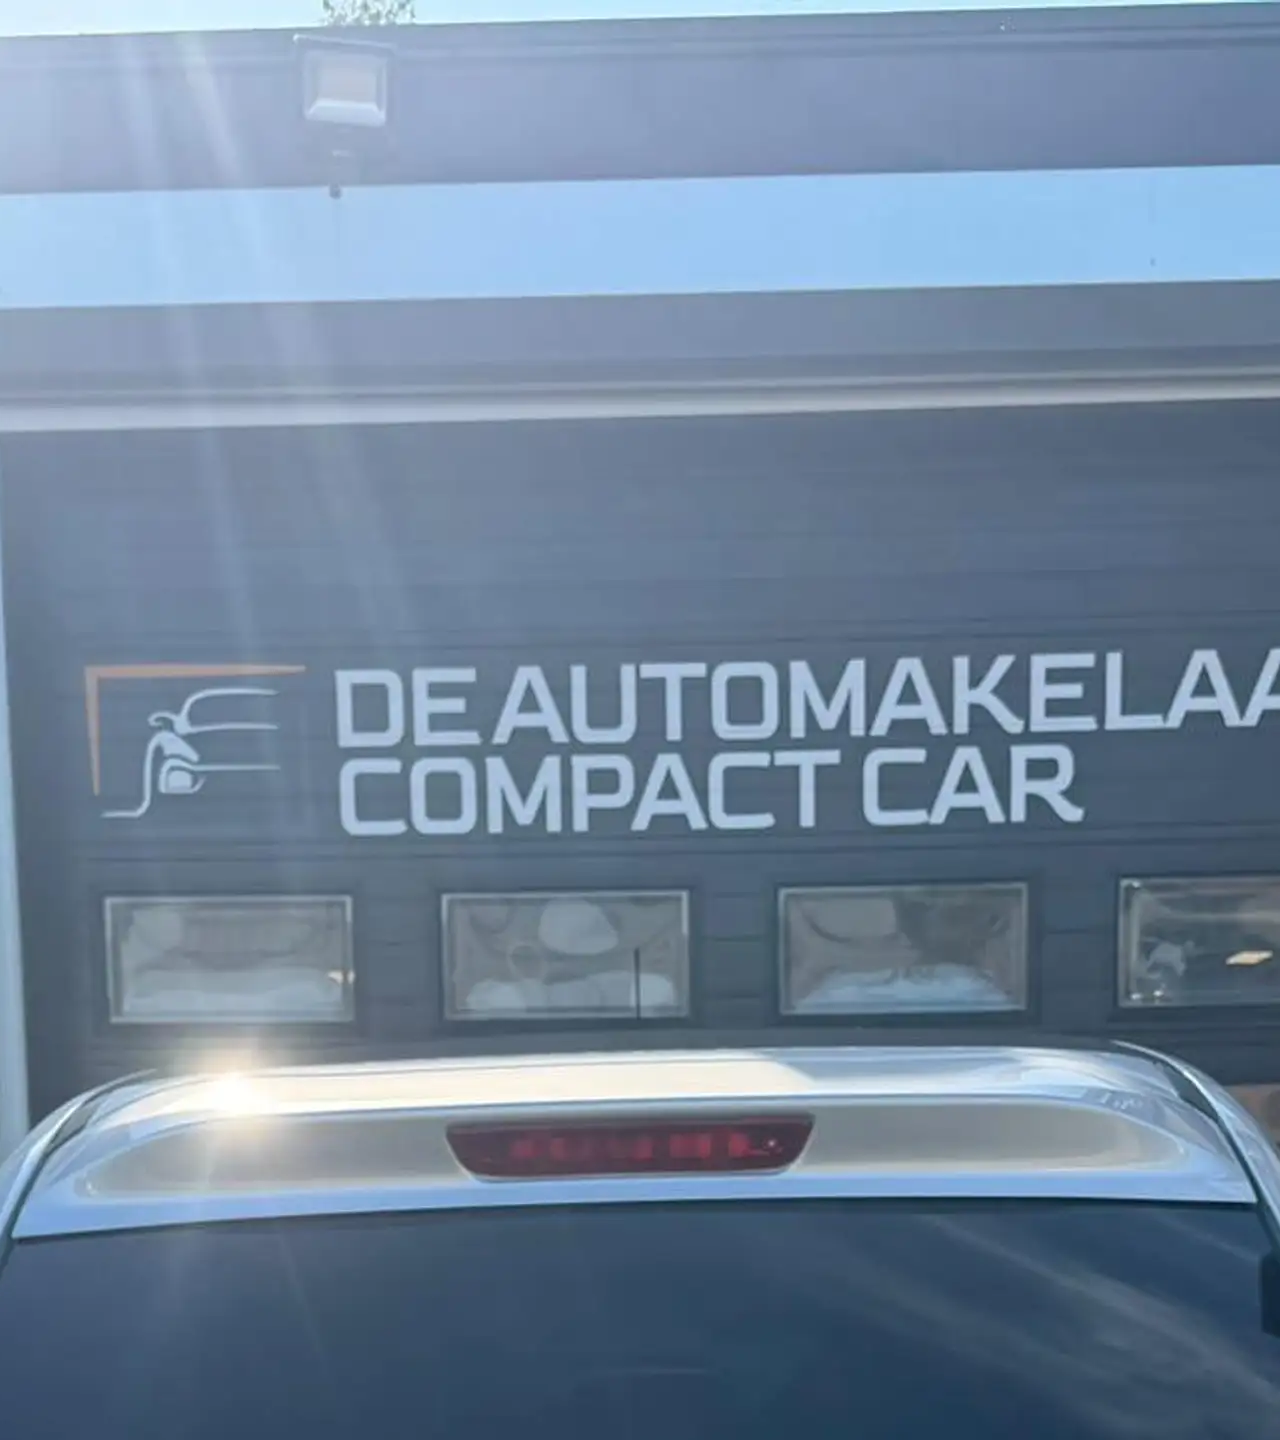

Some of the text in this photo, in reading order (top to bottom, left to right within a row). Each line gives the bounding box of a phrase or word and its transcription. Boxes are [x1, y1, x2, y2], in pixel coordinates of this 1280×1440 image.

[334, 665, 476, 749] DE
[338, 743, 1086, 837] COMPACT CAR
